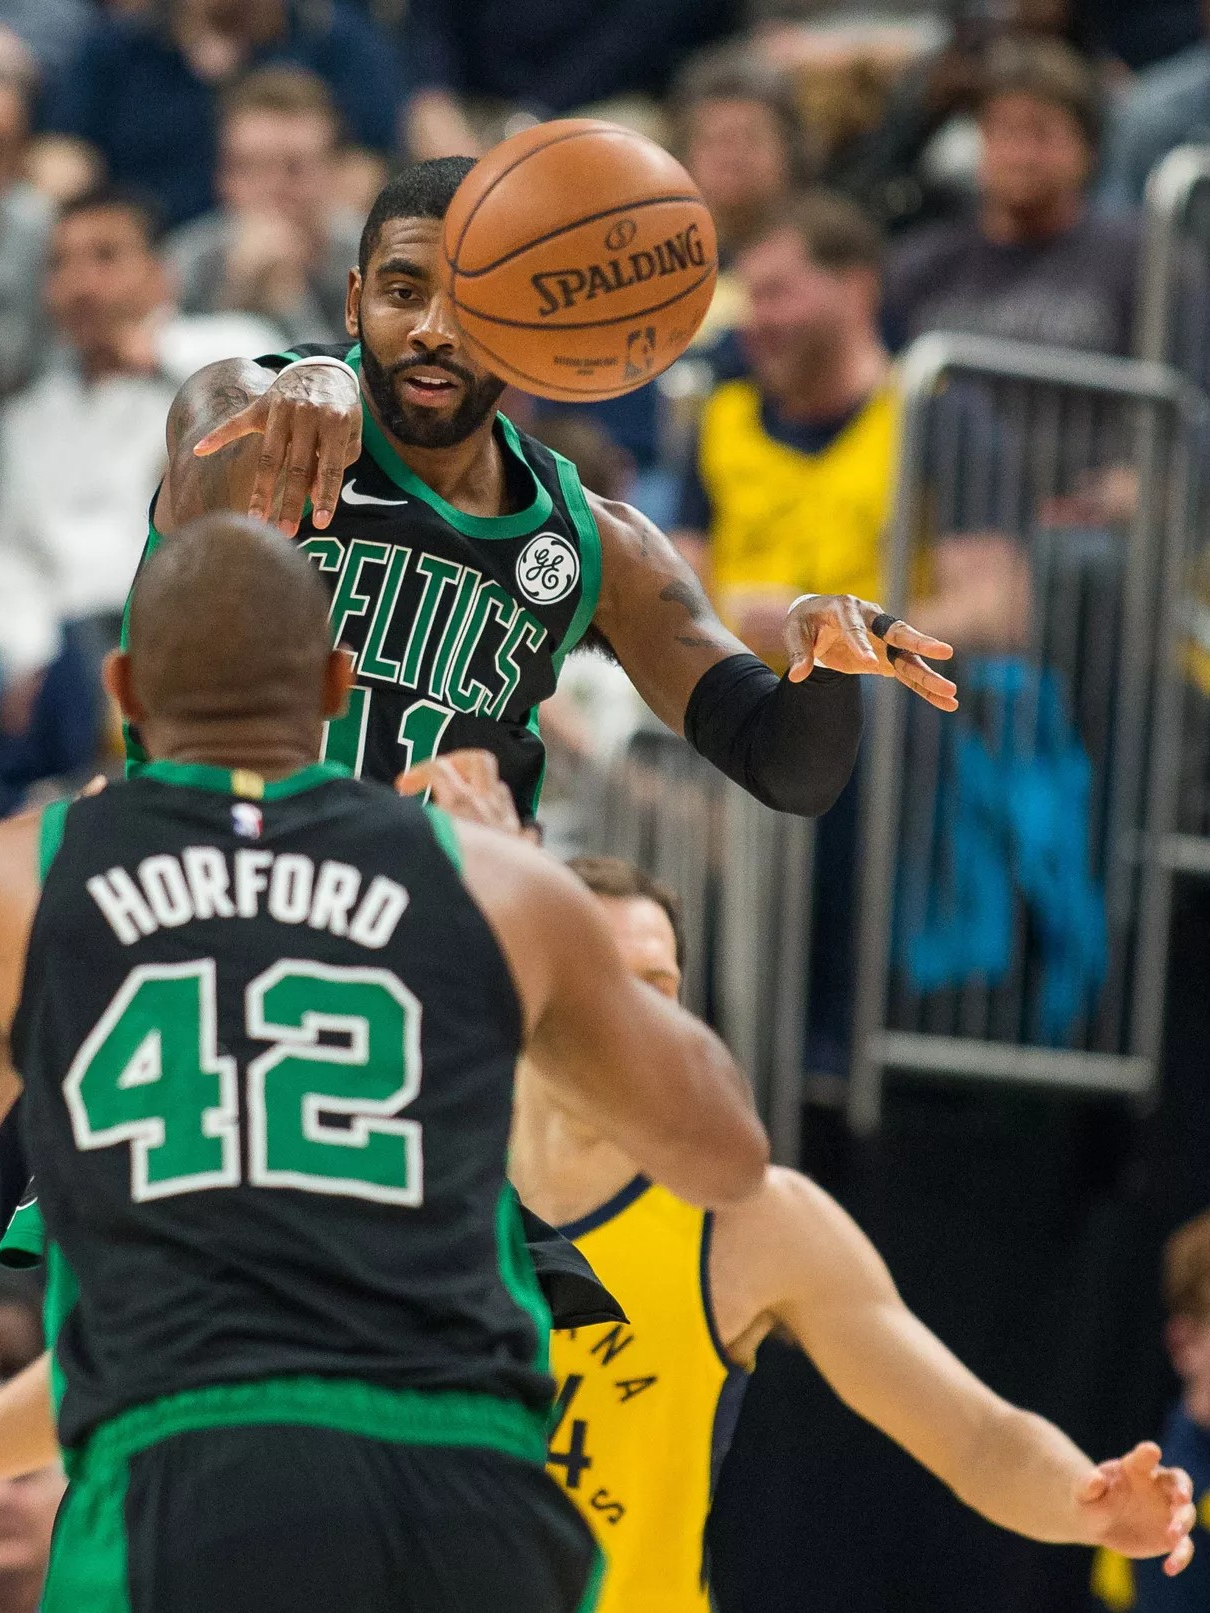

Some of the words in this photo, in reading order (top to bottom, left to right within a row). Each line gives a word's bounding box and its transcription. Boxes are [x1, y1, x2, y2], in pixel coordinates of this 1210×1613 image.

[531, 224, 705, 317] SPALDING
[86, 846, 410, 949] HORFORD
[62, 957, 424, 1208] 42
